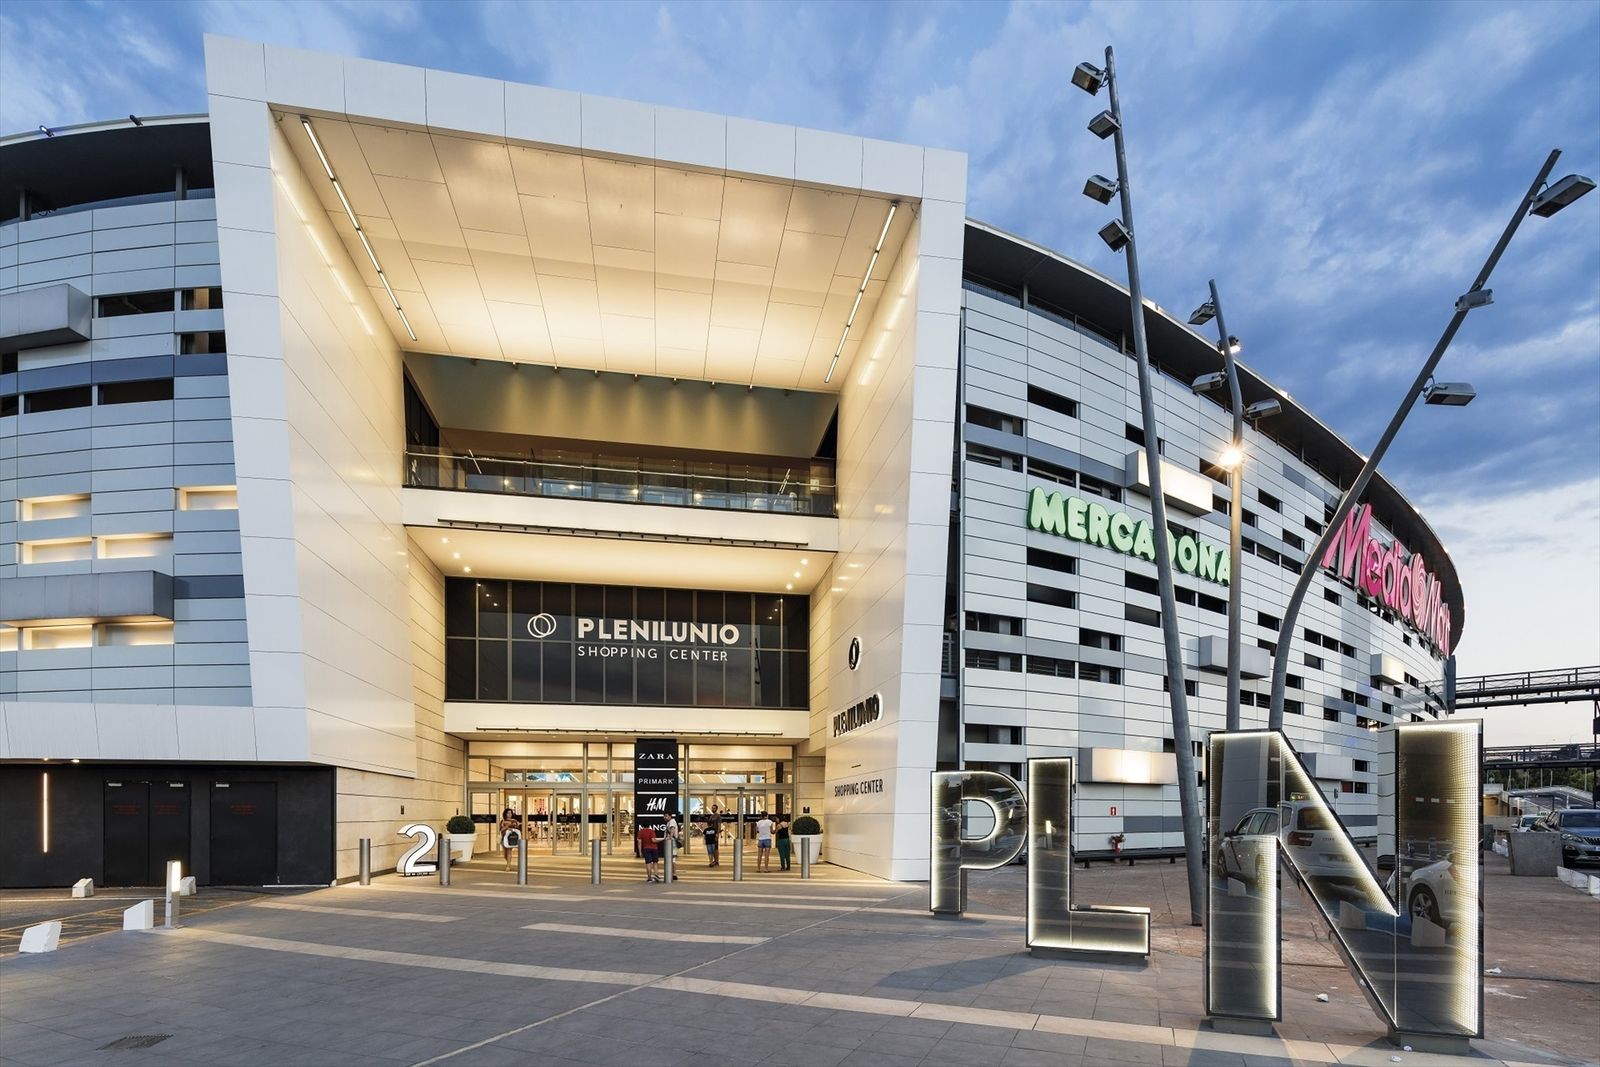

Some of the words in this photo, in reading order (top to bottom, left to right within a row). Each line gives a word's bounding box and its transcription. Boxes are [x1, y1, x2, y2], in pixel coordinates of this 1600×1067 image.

[577, 618, 740, 645] PLENILUNIO
[577, 646, 658, 659] SHOPPING
[669, 649, 728, 662] CENTER
[833, 694, 880, 737] PLENILUNIO
[834, 783, 859, 797] SHOPPING
[859, 778, 884, 795] CENTER
[646, 797, 667, 811] H&M
[638, 823, 667, 831] MANG
[397, 823, 437, 876] 2
